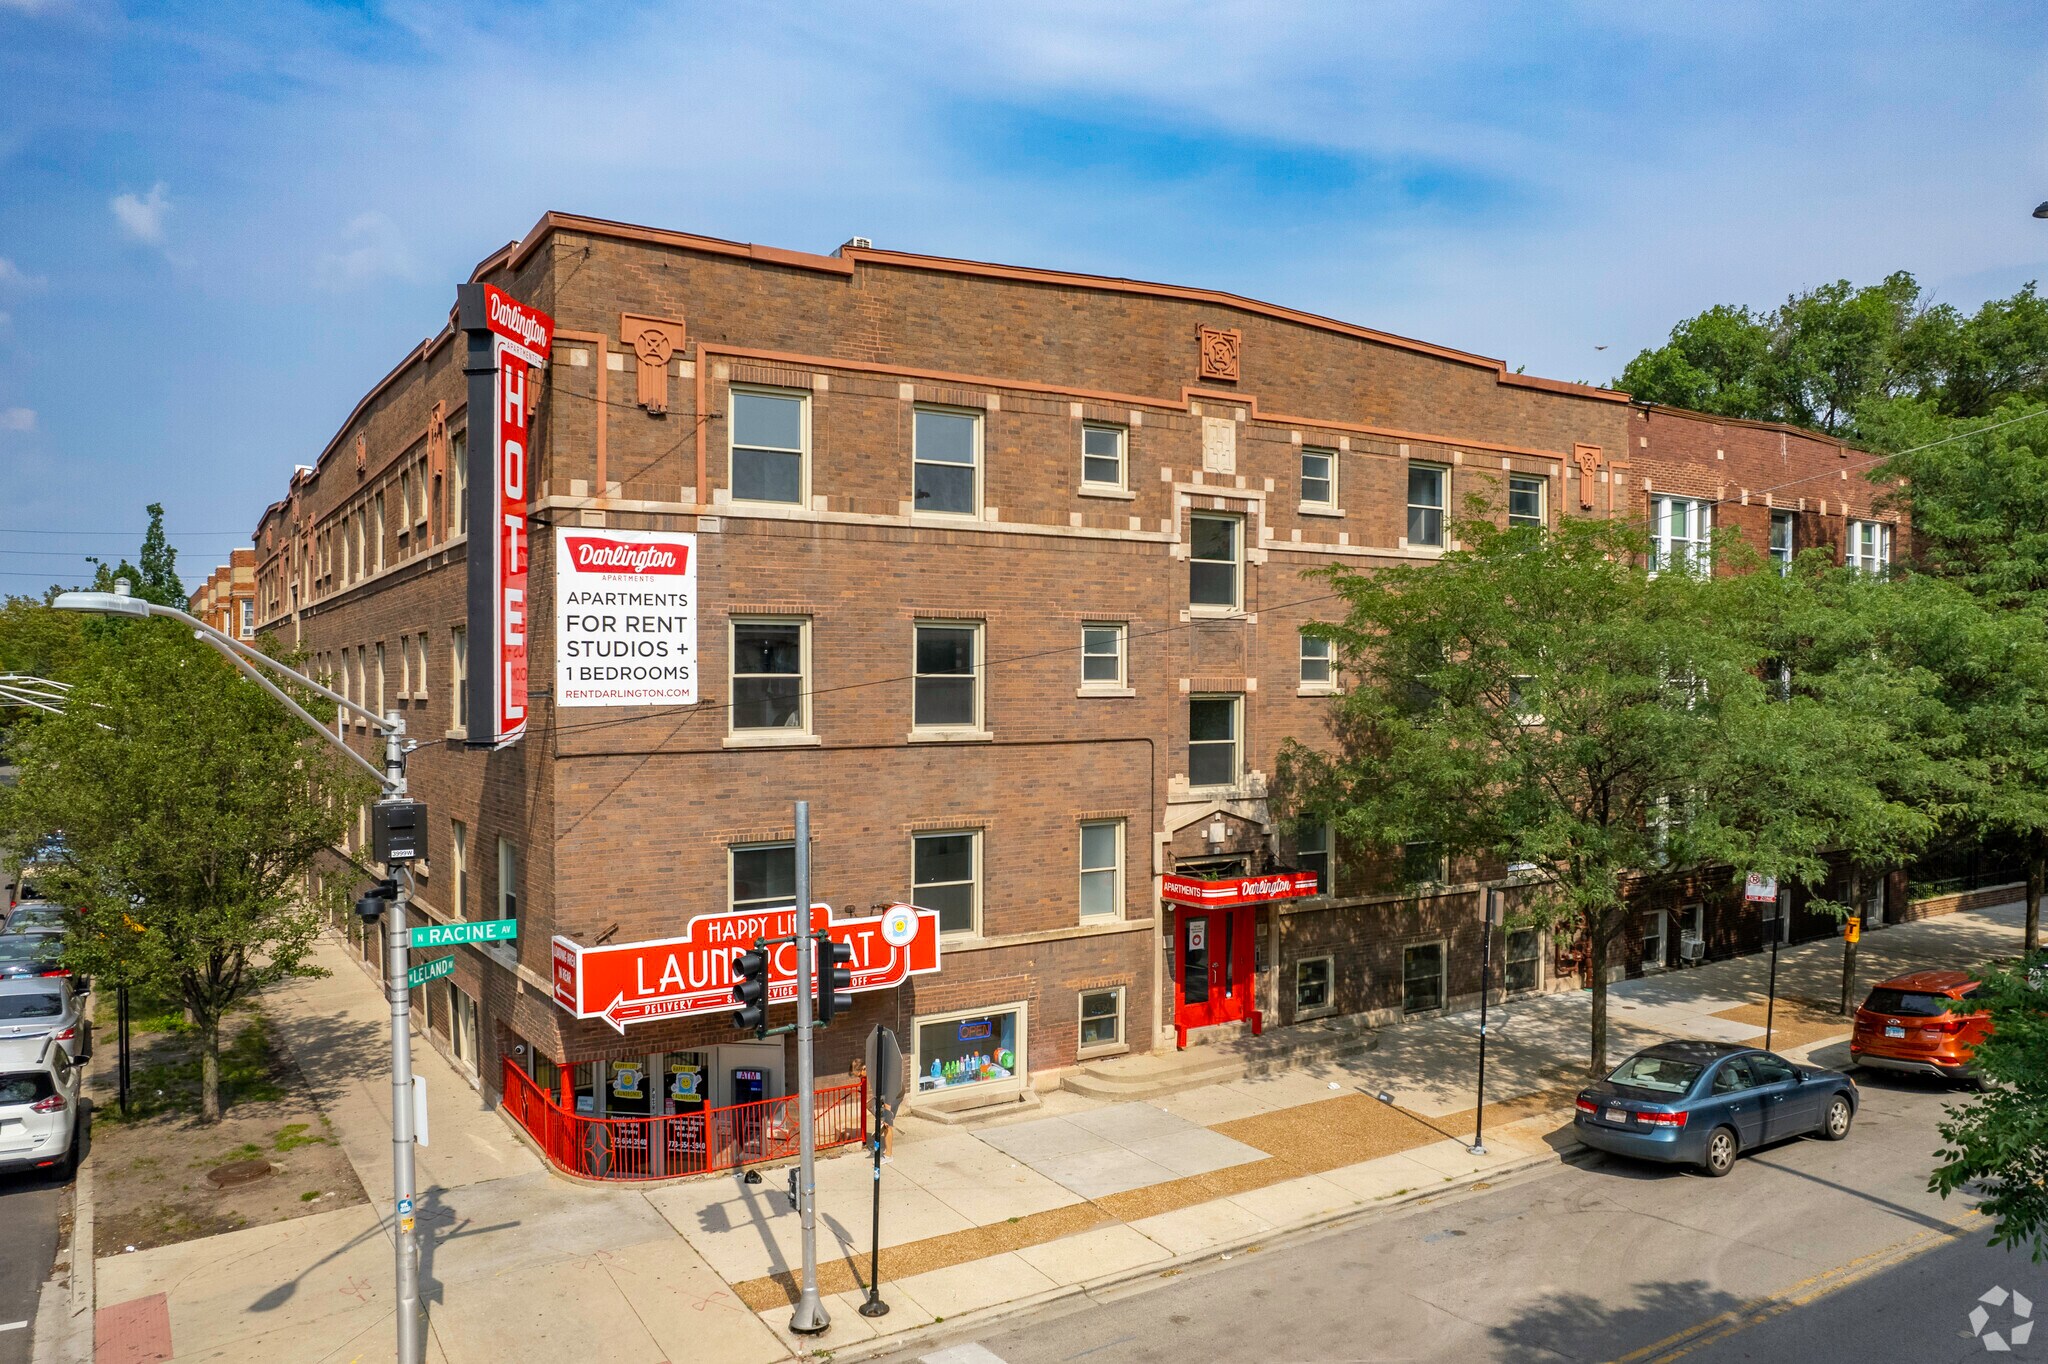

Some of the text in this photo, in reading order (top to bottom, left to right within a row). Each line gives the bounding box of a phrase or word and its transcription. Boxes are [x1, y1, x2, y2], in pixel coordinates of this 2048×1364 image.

[490, 293, 547, 348] Darlington
[507, 341, 538, 363] APARTMENTS
[505, 364, 524, 720] HOTEL
[578, 543, 676, 573] Darlington
[602, 574, 655, 583] APARTMENTS
[566, 591, 688, 607] APARTMENTS
[566, 615, 688, 633] FOR RENT
[566, 640, 669, 658] STUDIOS
[566, 666, 689, 681] 1 BEDROOMS
[565, 688, 690, 699] RENTDARLINGTON.COM
[1163, 882, 1201, 897] APARTMENTS
[1241, 877, 1292, 897] Darlington
[417, 923, 511, 944] N RACINE AV
[708, 916, 768, 943] HAPPY
[413, 960, 448, 983] LELAND
[852, 977, 868, 987] OFF
[644, 1000, 693, 1015] DELIVERY
[960, 1024, 990, 1038] OPEN
[740, 1071, 758, 1080] ATM
